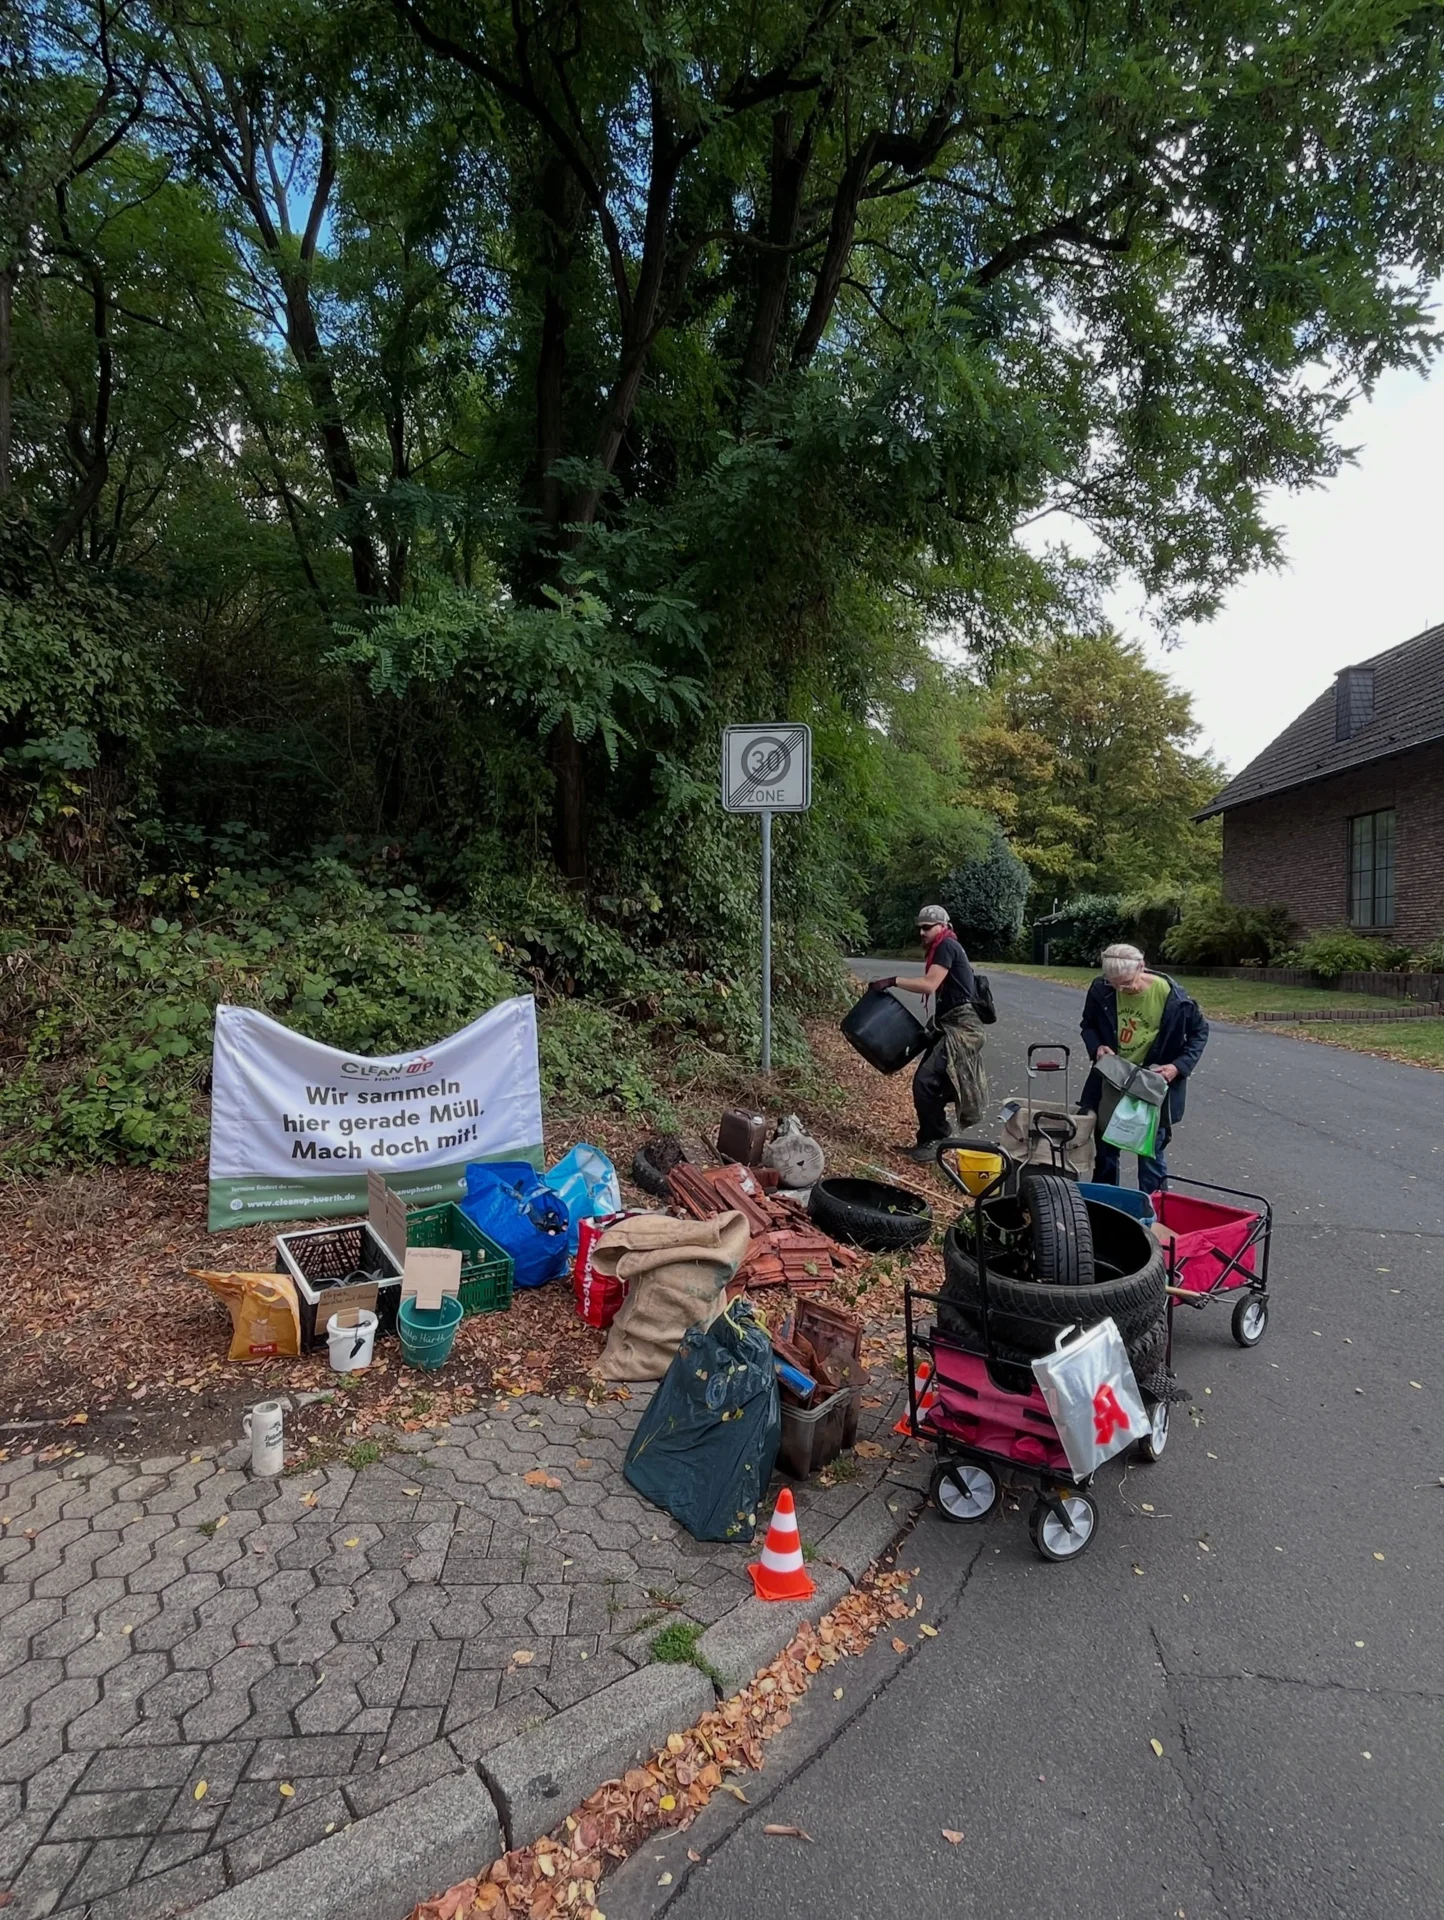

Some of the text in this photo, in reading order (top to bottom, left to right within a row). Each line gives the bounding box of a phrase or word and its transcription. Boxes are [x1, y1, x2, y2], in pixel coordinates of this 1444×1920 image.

[747, 789, 785, 803] ZONE
[305, 1078, 460, 1106] Wir sammeln
[282, 1113, 331, 1132] hier
[338, 1109, 420, 1136] gerade
[291, 1123, 478, 1159] Mach doch mit!
[247, 1193, 356, 1208] www.cleanup-huerth.de
